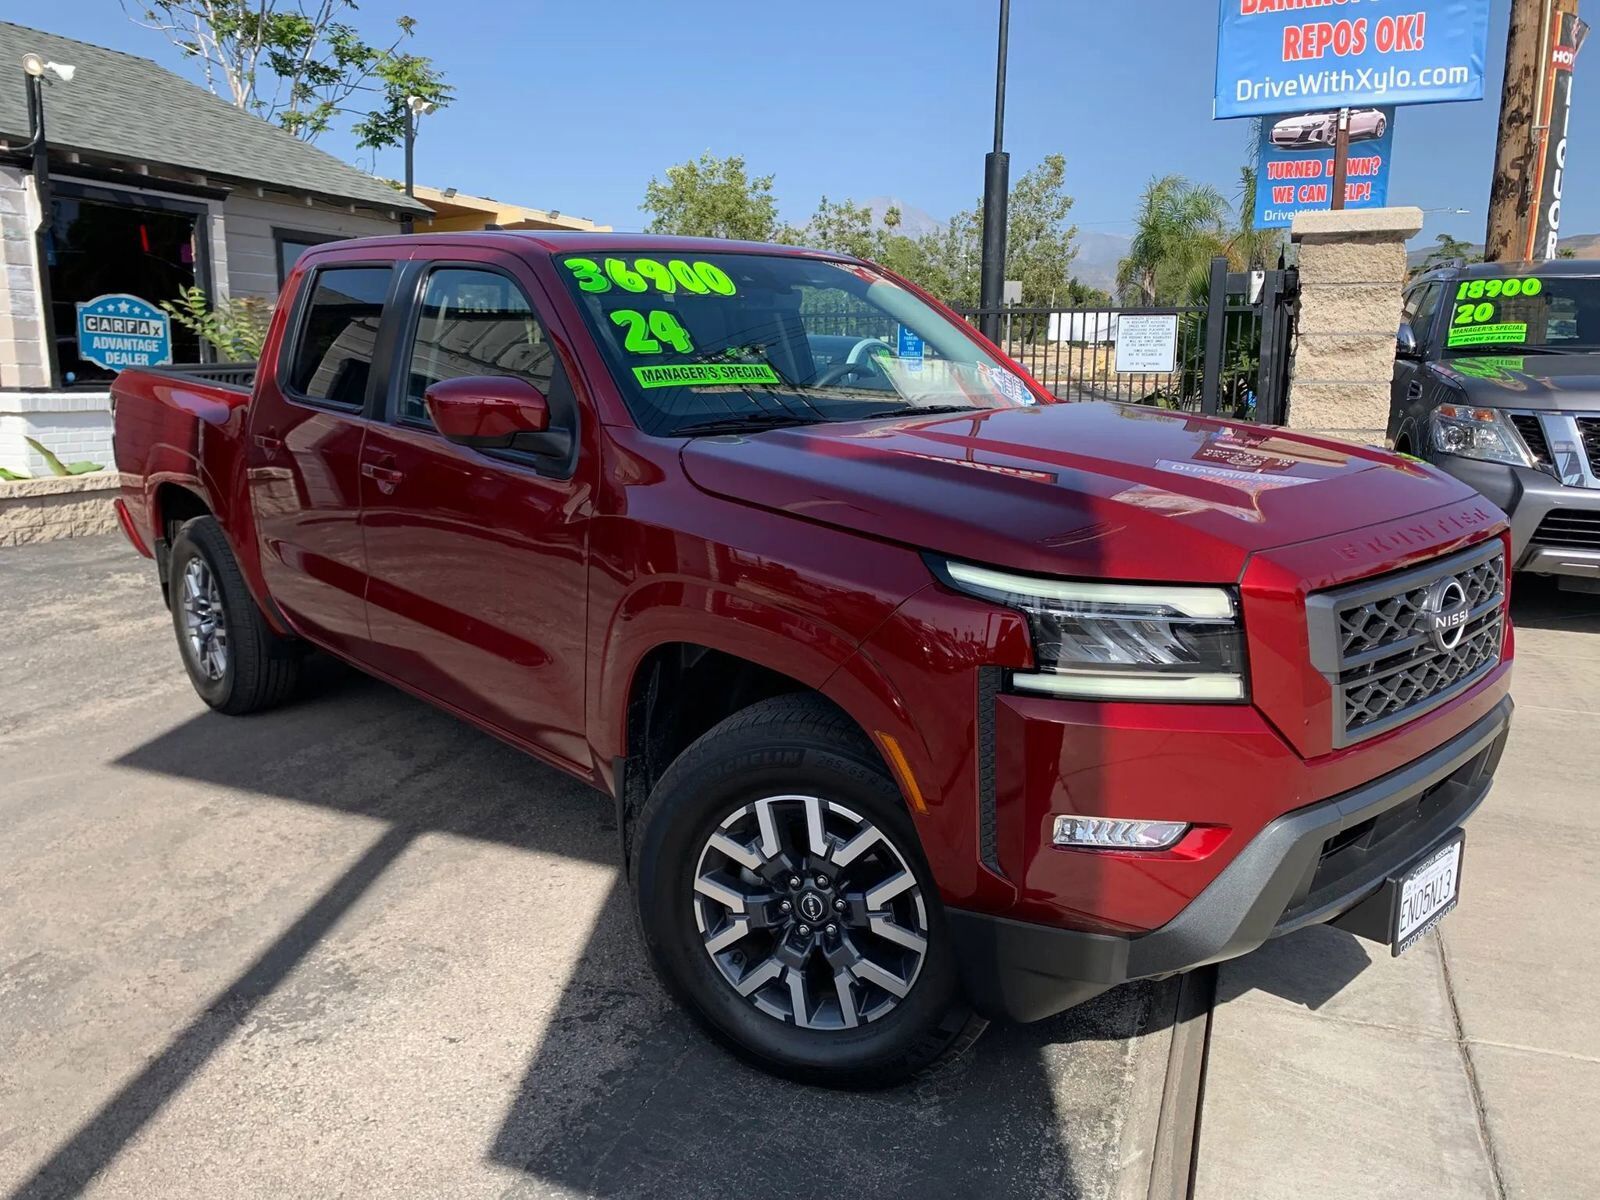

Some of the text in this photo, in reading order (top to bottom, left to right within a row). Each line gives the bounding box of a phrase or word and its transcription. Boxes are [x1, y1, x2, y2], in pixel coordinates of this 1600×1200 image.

[1282, 12, 1426, 61] REPOS OK!
[1236, 66, 1469, 101] DriveWithXylo.com
[1268, 156, 1382, 179] TURNED DWN?
[1272, 181, 1372, 204] WE CAN ELP!
[564, 258, 736, 295] 36900
[1456, 278, 1542, 300] 18900
[1454, 302, 1494, 324] 20
[86, 317, 161, 336] CARFAX
[610, 309, 694, 354] 24
[1453, 326, 1493, 335] MANAGER'S
[93, 336, 159, 352] ADVANTAGE
[105, 352, 149, 366] DEALER
[641, 366, 771, 382] MANAGER'S SPECIAL
